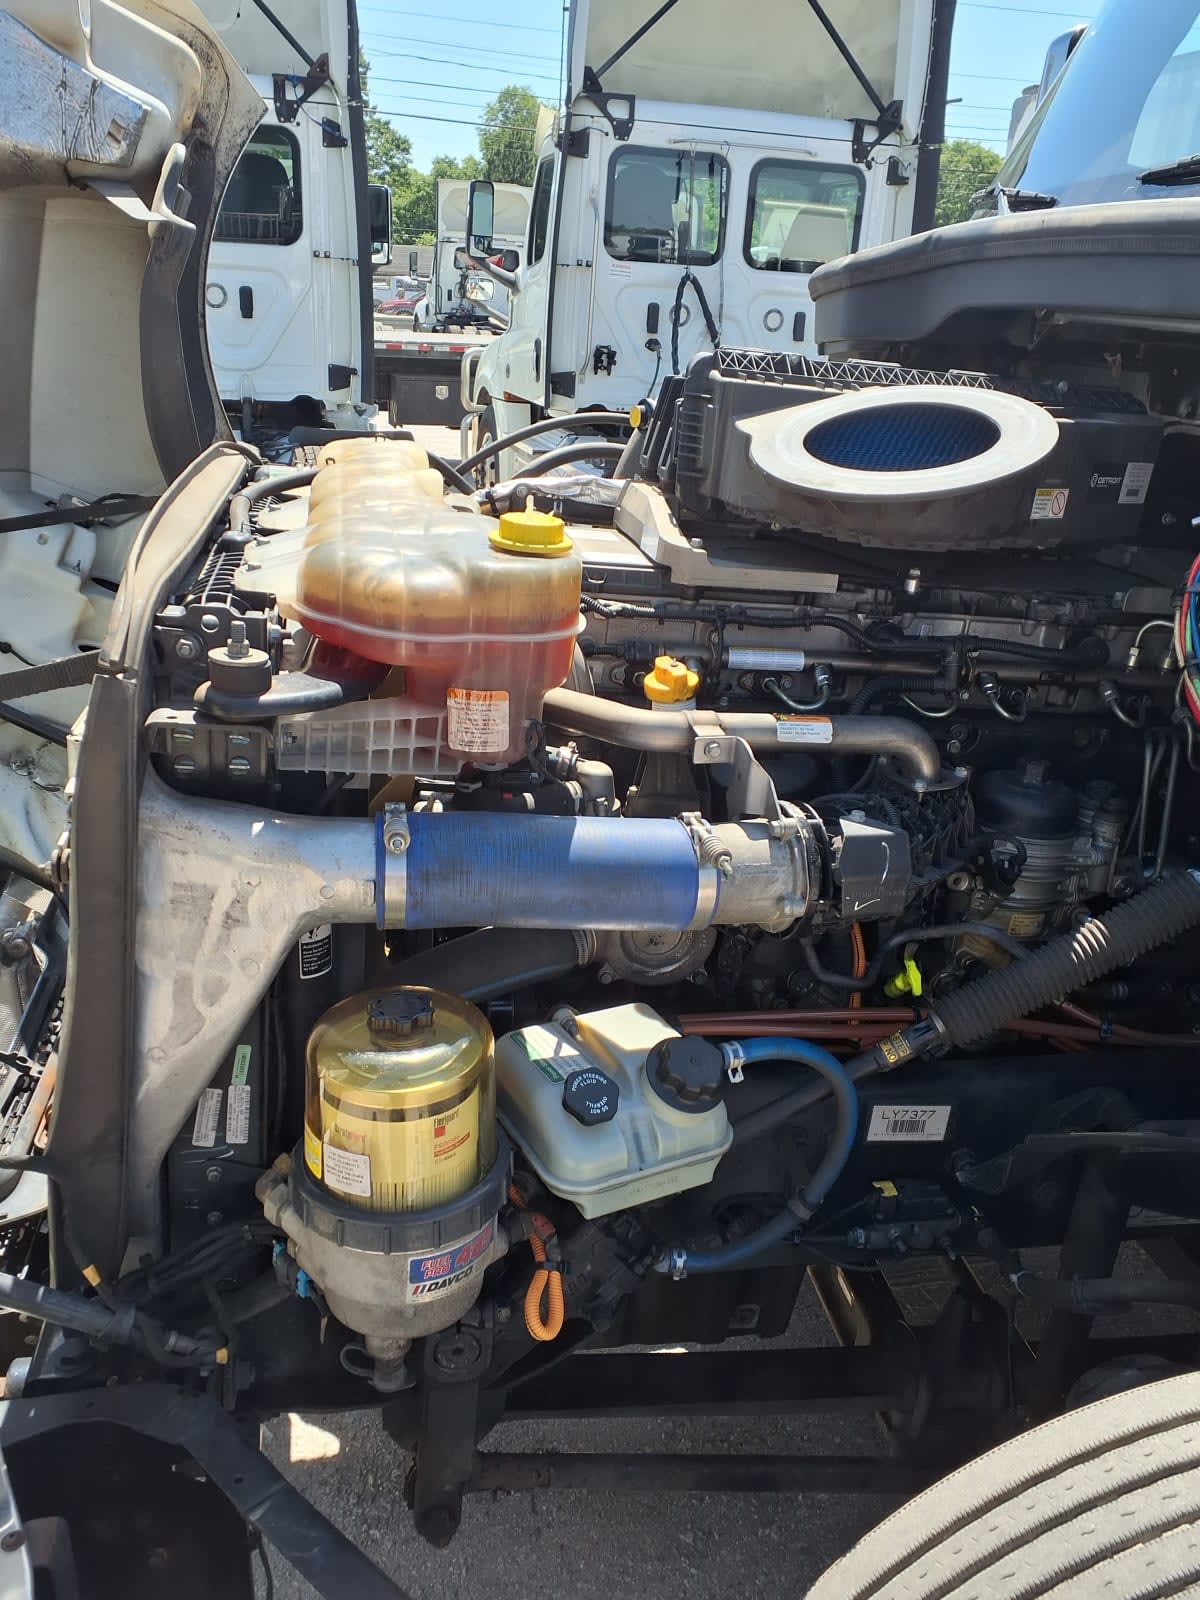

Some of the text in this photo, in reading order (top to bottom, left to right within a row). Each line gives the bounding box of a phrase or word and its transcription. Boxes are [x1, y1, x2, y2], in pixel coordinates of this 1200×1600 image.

[1097, 476, 1121, 484] DETROIT
[580, 1079, 597, 1088] FLUID
[583, 1073, 608, 1085] STEERING
[586, 1096, 608, 1109] OVERFILL
[881, 1110, 937, 1120] LY7377
[426, 1265, 474, 1293] DAVCO
